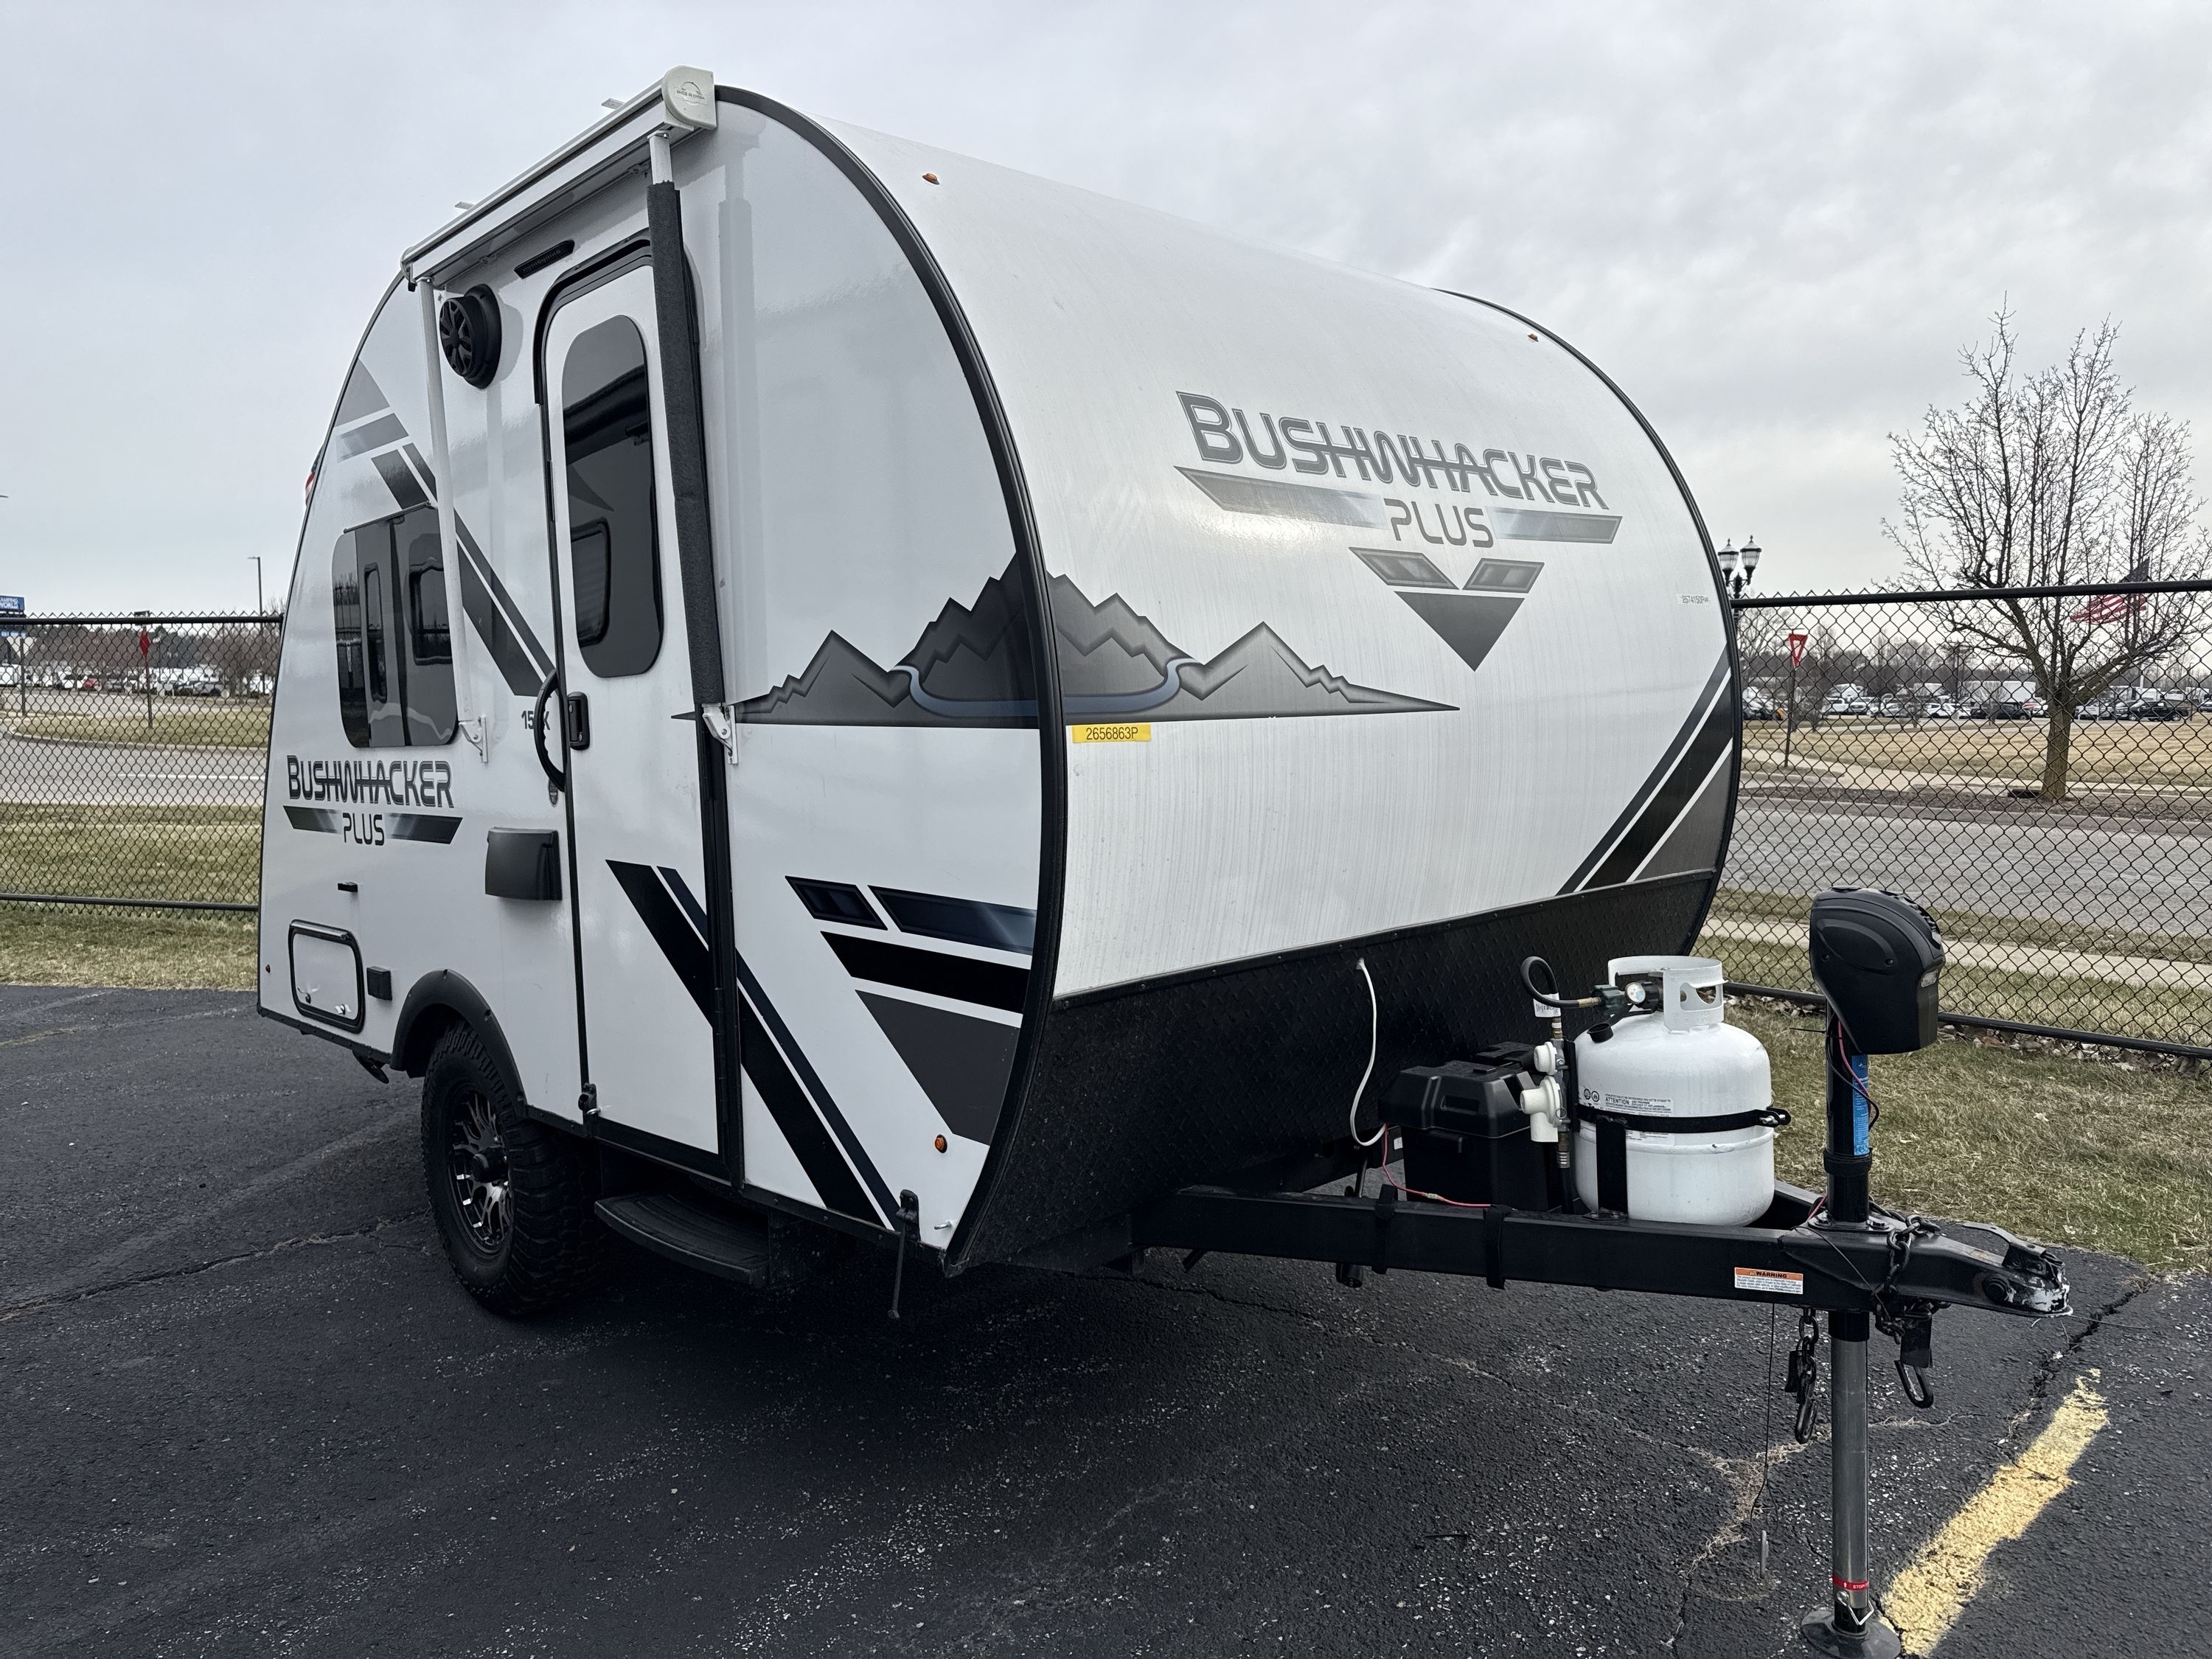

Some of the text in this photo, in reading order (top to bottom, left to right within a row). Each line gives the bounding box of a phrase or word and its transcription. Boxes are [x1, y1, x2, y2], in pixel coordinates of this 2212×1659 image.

[1175, 390, 1610, 510] BUSHWHACKER
[1383, 498, 1494, 549] PLUS
[521, 710, 551, 731] 15K
[1085, 726, 1138, 740] 2656863P
[287, 755, 455, 809] BUSHWHACKER
[342, 813, 385, 846] PLUS
